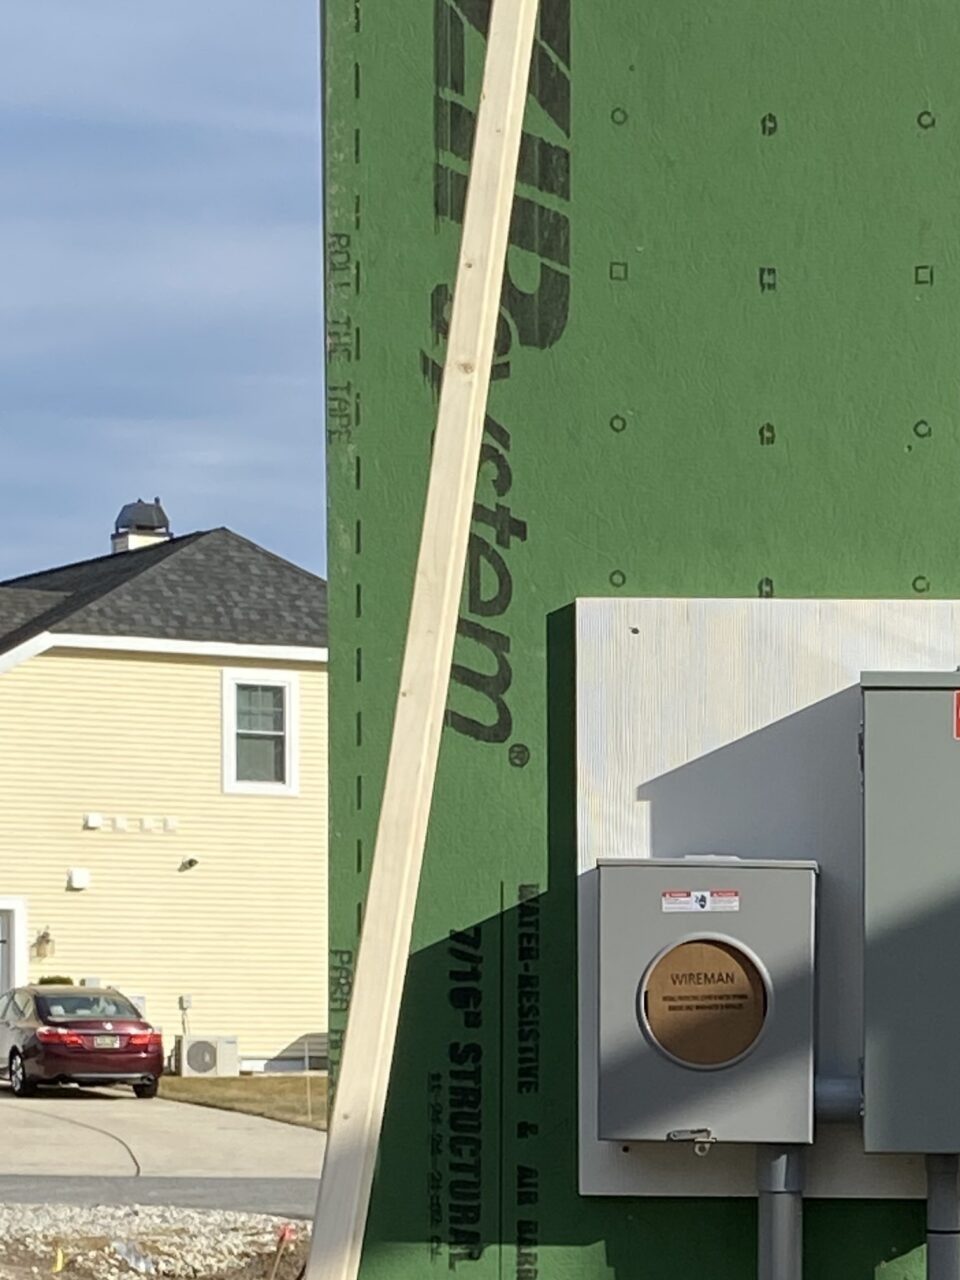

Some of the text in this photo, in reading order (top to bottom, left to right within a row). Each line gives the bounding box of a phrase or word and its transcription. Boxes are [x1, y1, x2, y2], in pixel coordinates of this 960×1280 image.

[328, 381, 352, 445] TAPE
[448, 926, 483, 1029] 7/16"
[517, 883, 541, 1095] WATER-RESISTIVE
[670, 971, 736, 986] WIREMAN
[447, 1041, 483, 1271] STRUCTURAL
[516, 1121, 539, 1139] &
[516, 1165, 539, 1207] AIR
